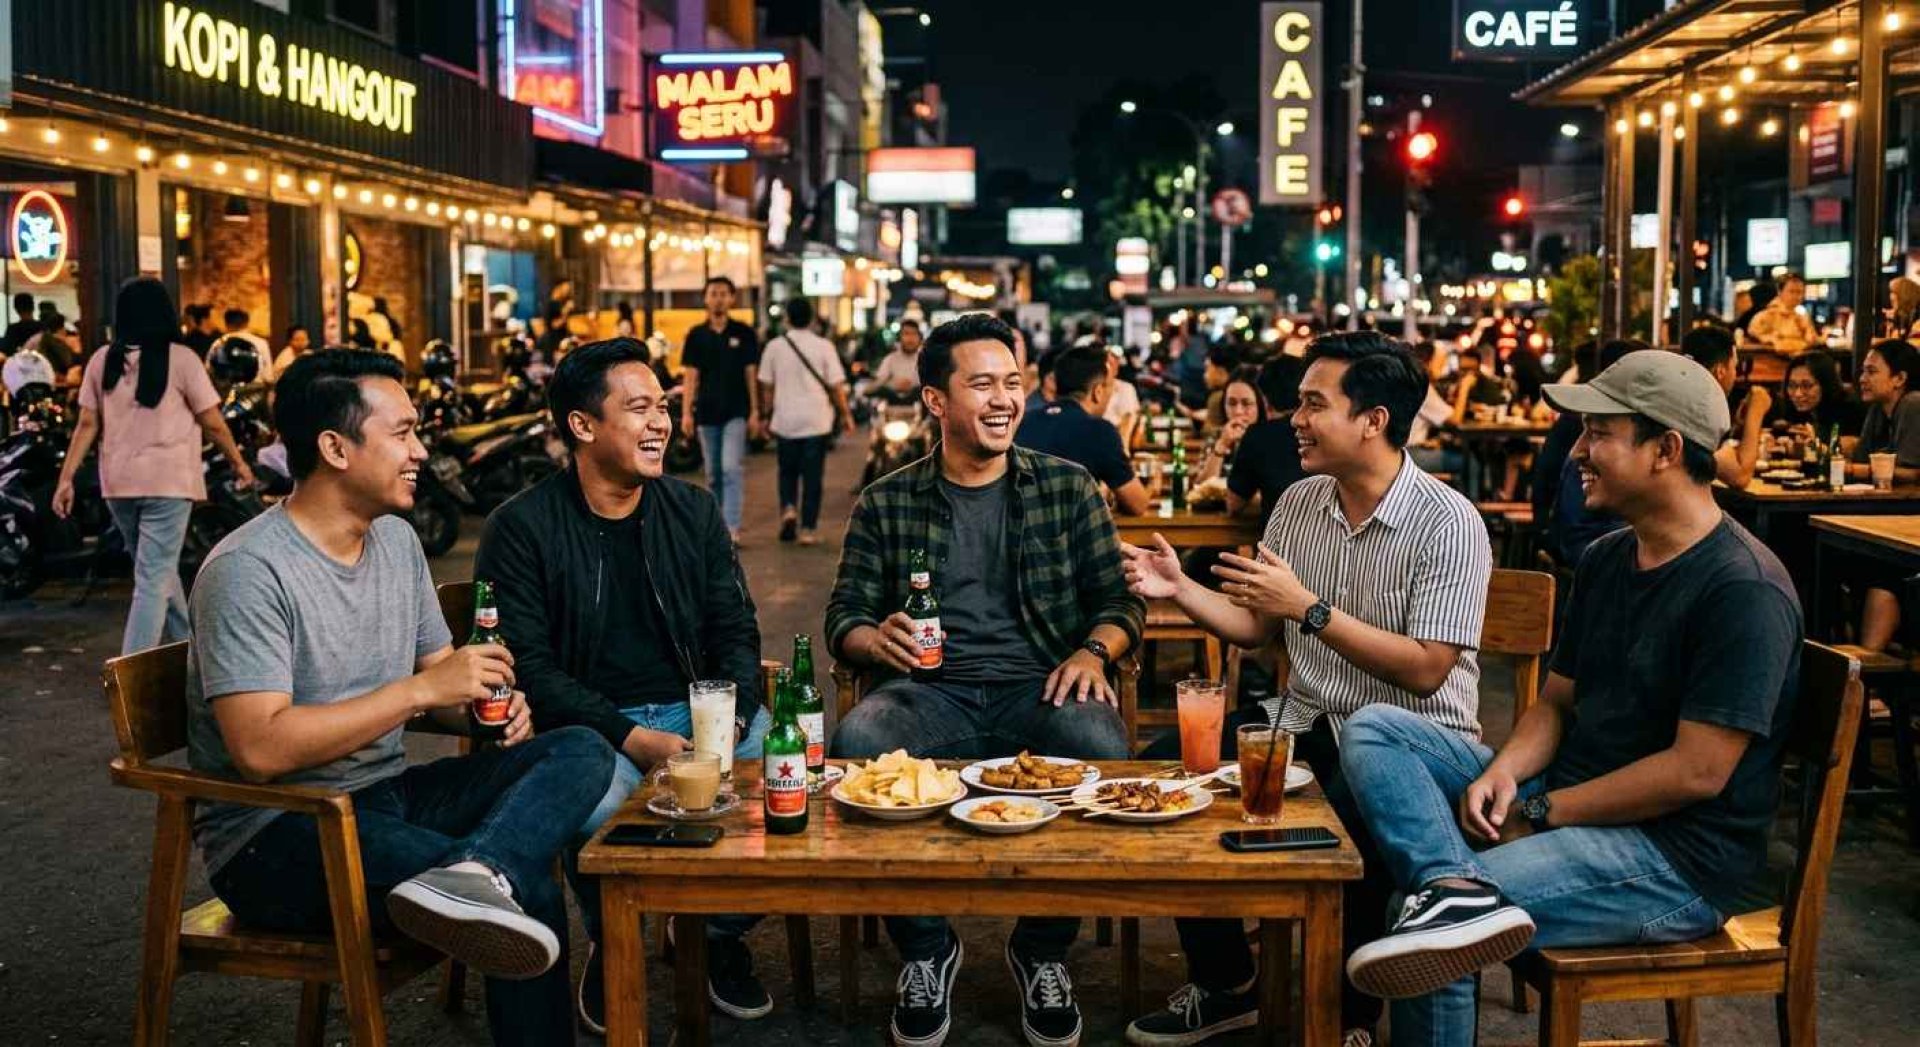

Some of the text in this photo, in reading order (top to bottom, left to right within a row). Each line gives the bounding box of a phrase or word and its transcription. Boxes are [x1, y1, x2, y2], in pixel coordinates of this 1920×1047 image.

[1465, 1, 1578, 47] CAFÉ
[164, 1, 417, 134] KOPI & HANGOUT
[657, 62, 792, 109] MALAM
[678, 98, 774, 140] SERU
[1272, 11, 1312, 196] CAFE
